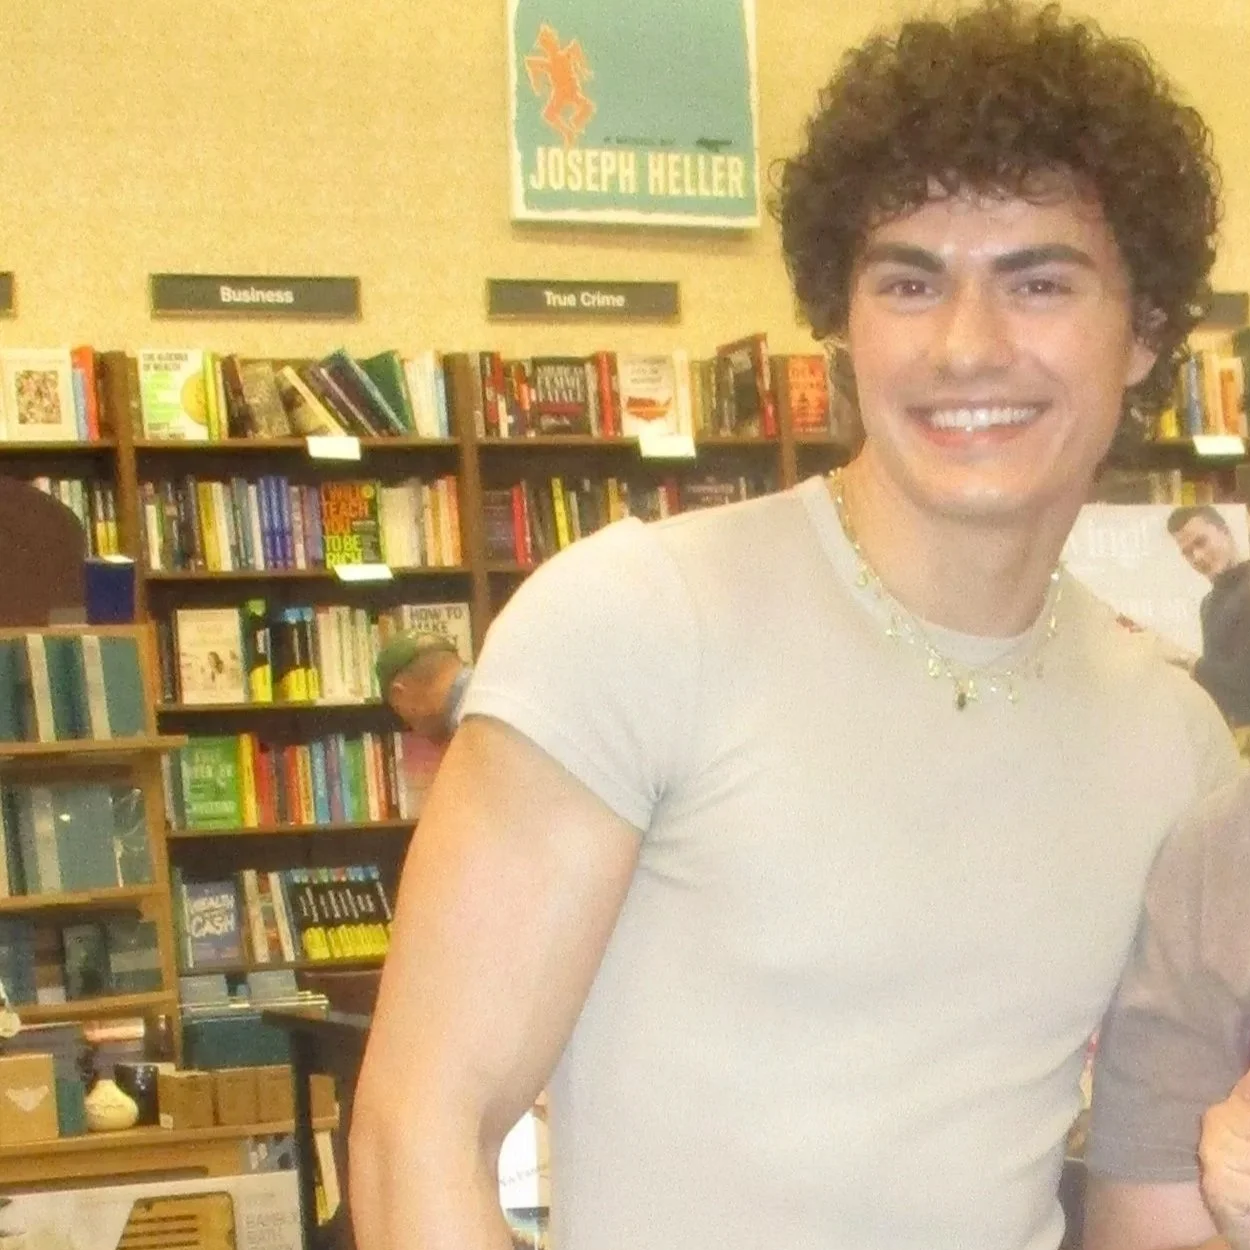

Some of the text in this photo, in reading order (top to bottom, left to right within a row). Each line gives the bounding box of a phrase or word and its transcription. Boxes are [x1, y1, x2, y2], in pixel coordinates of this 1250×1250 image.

[529, 148, 745, 198] JOSEPH HELLER
[220, 285, 294, 304] Business
[545, 292, 625, 307] True Crime
[324, 501, 368, 519] TEACH
[324, 534, 361, 552] TO BE
[445, 606, 463, 619] TO
